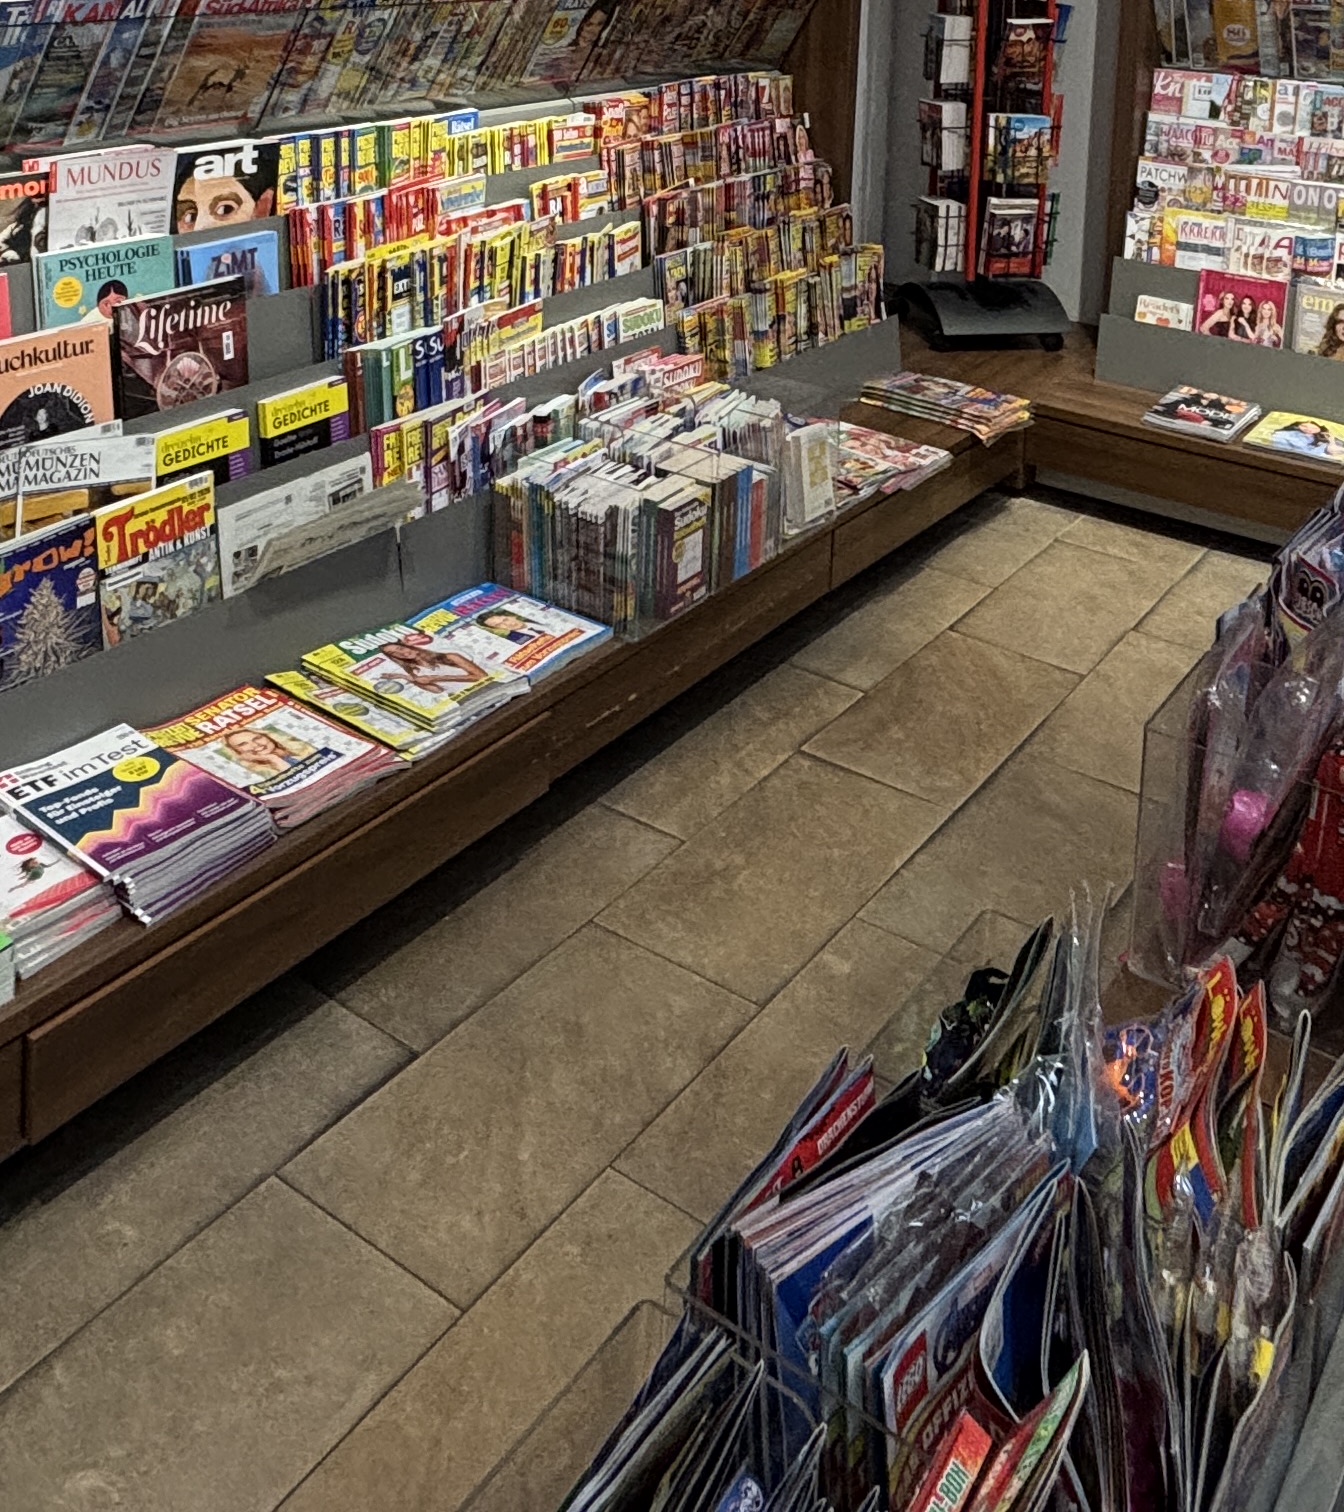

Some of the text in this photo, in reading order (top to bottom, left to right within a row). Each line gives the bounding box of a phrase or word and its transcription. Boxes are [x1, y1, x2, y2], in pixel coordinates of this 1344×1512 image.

[65, 157, 163, 190] MUNDUS
[193, 144, 260, 181] art
[58, 241, 161, 276] PSYCHOLOGIE
[83, 260, 138, 284] HEUTE
[132, 296, 234, 355] Lifetime
[271, 399, 331, 430] GEDICHTE
[22, 451, 102, 475] MÜNZEN
[160, 433, 232, 470] GEDICHTE
[21, 466, 102, 488] MAGAZIN
[102, 501, 212, 565] Trödler
[6, 737, 151, 802] ETF im Test
